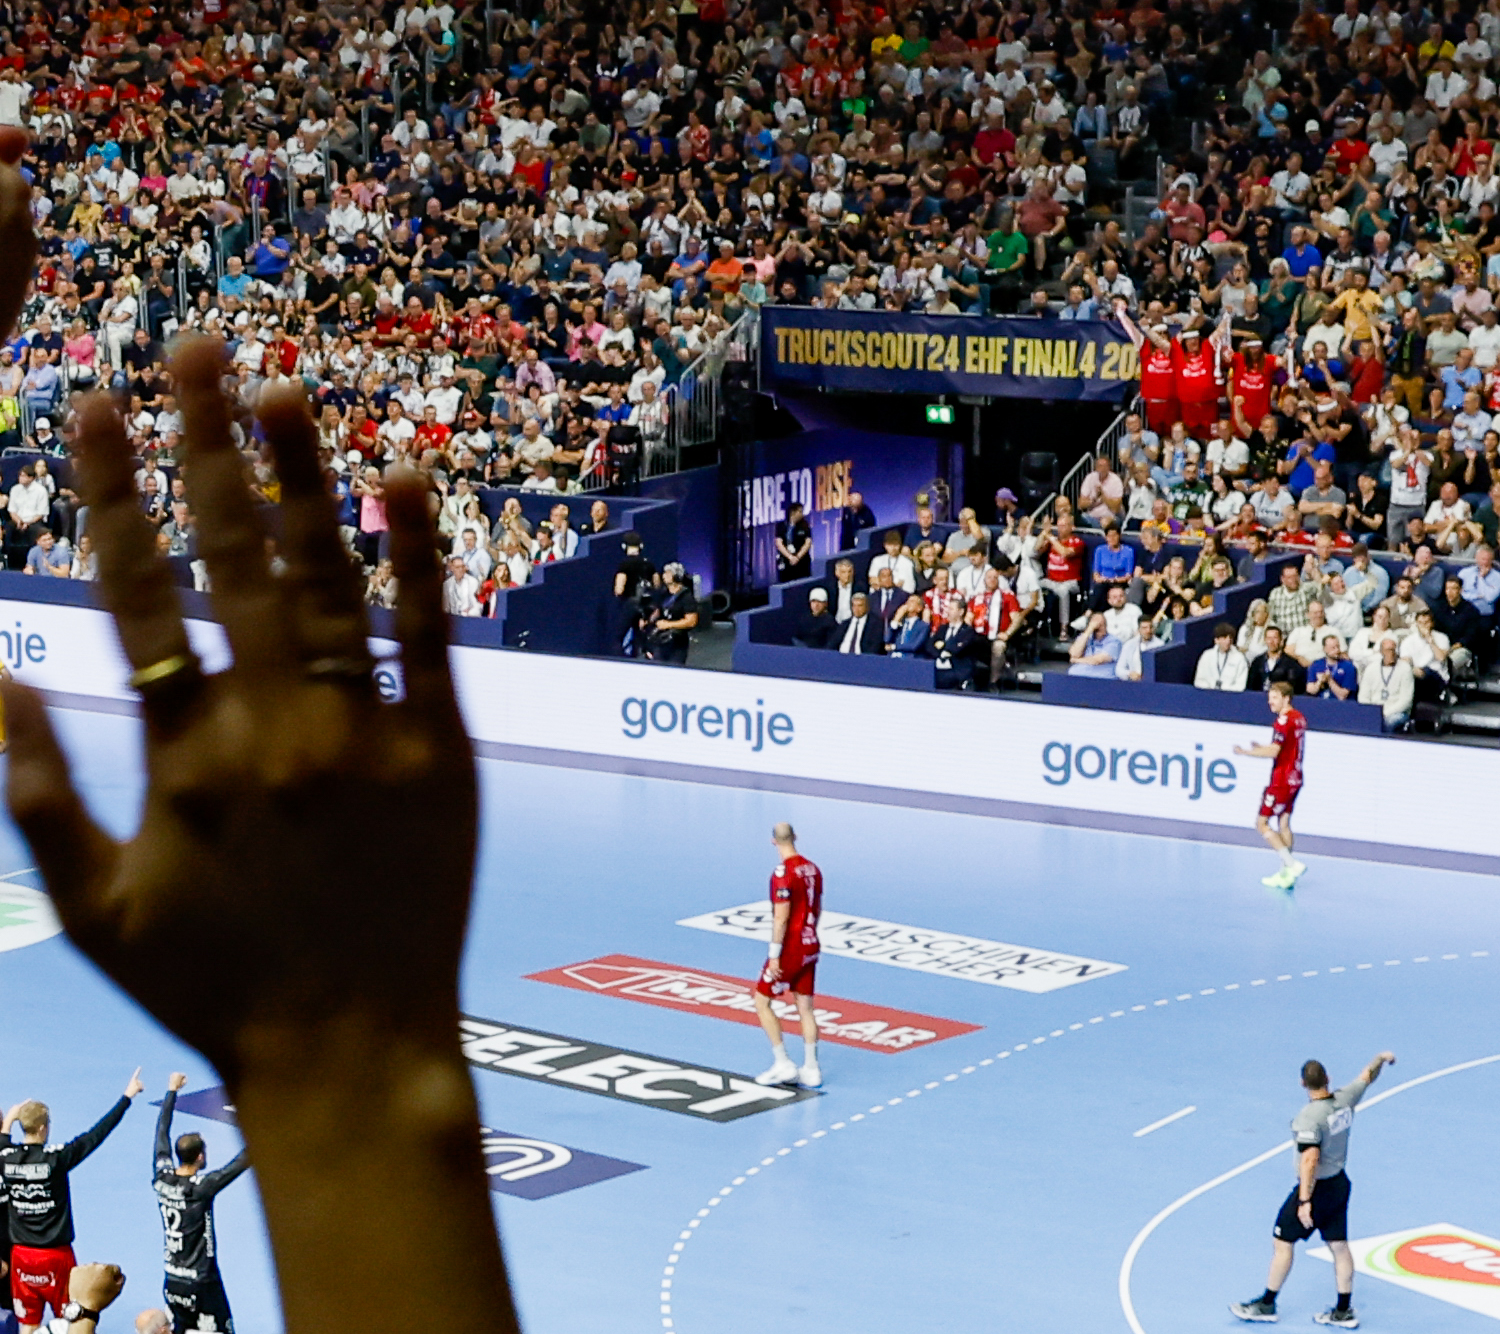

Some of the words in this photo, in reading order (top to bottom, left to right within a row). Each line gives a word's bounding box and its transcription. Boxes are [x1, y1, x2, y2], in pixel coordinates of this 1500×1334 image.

[774, 327, 960, 373] TRUCKSCOUT24
[965, 335, 1008, 370] EHF
[1012, 337, 1097, 379] FINAL4
[1100, 342, 1143, 381] 20
[788, 467, 812, 516] TO
[815, 460, 854, 512] RISE
[621, 695, 794, 751] gorenje
[1042, 740, 1237, 800] gorenje
[825, 919, 1109, 979] MASCHINEN
[826, 939, 1025, 982] SUCHER
